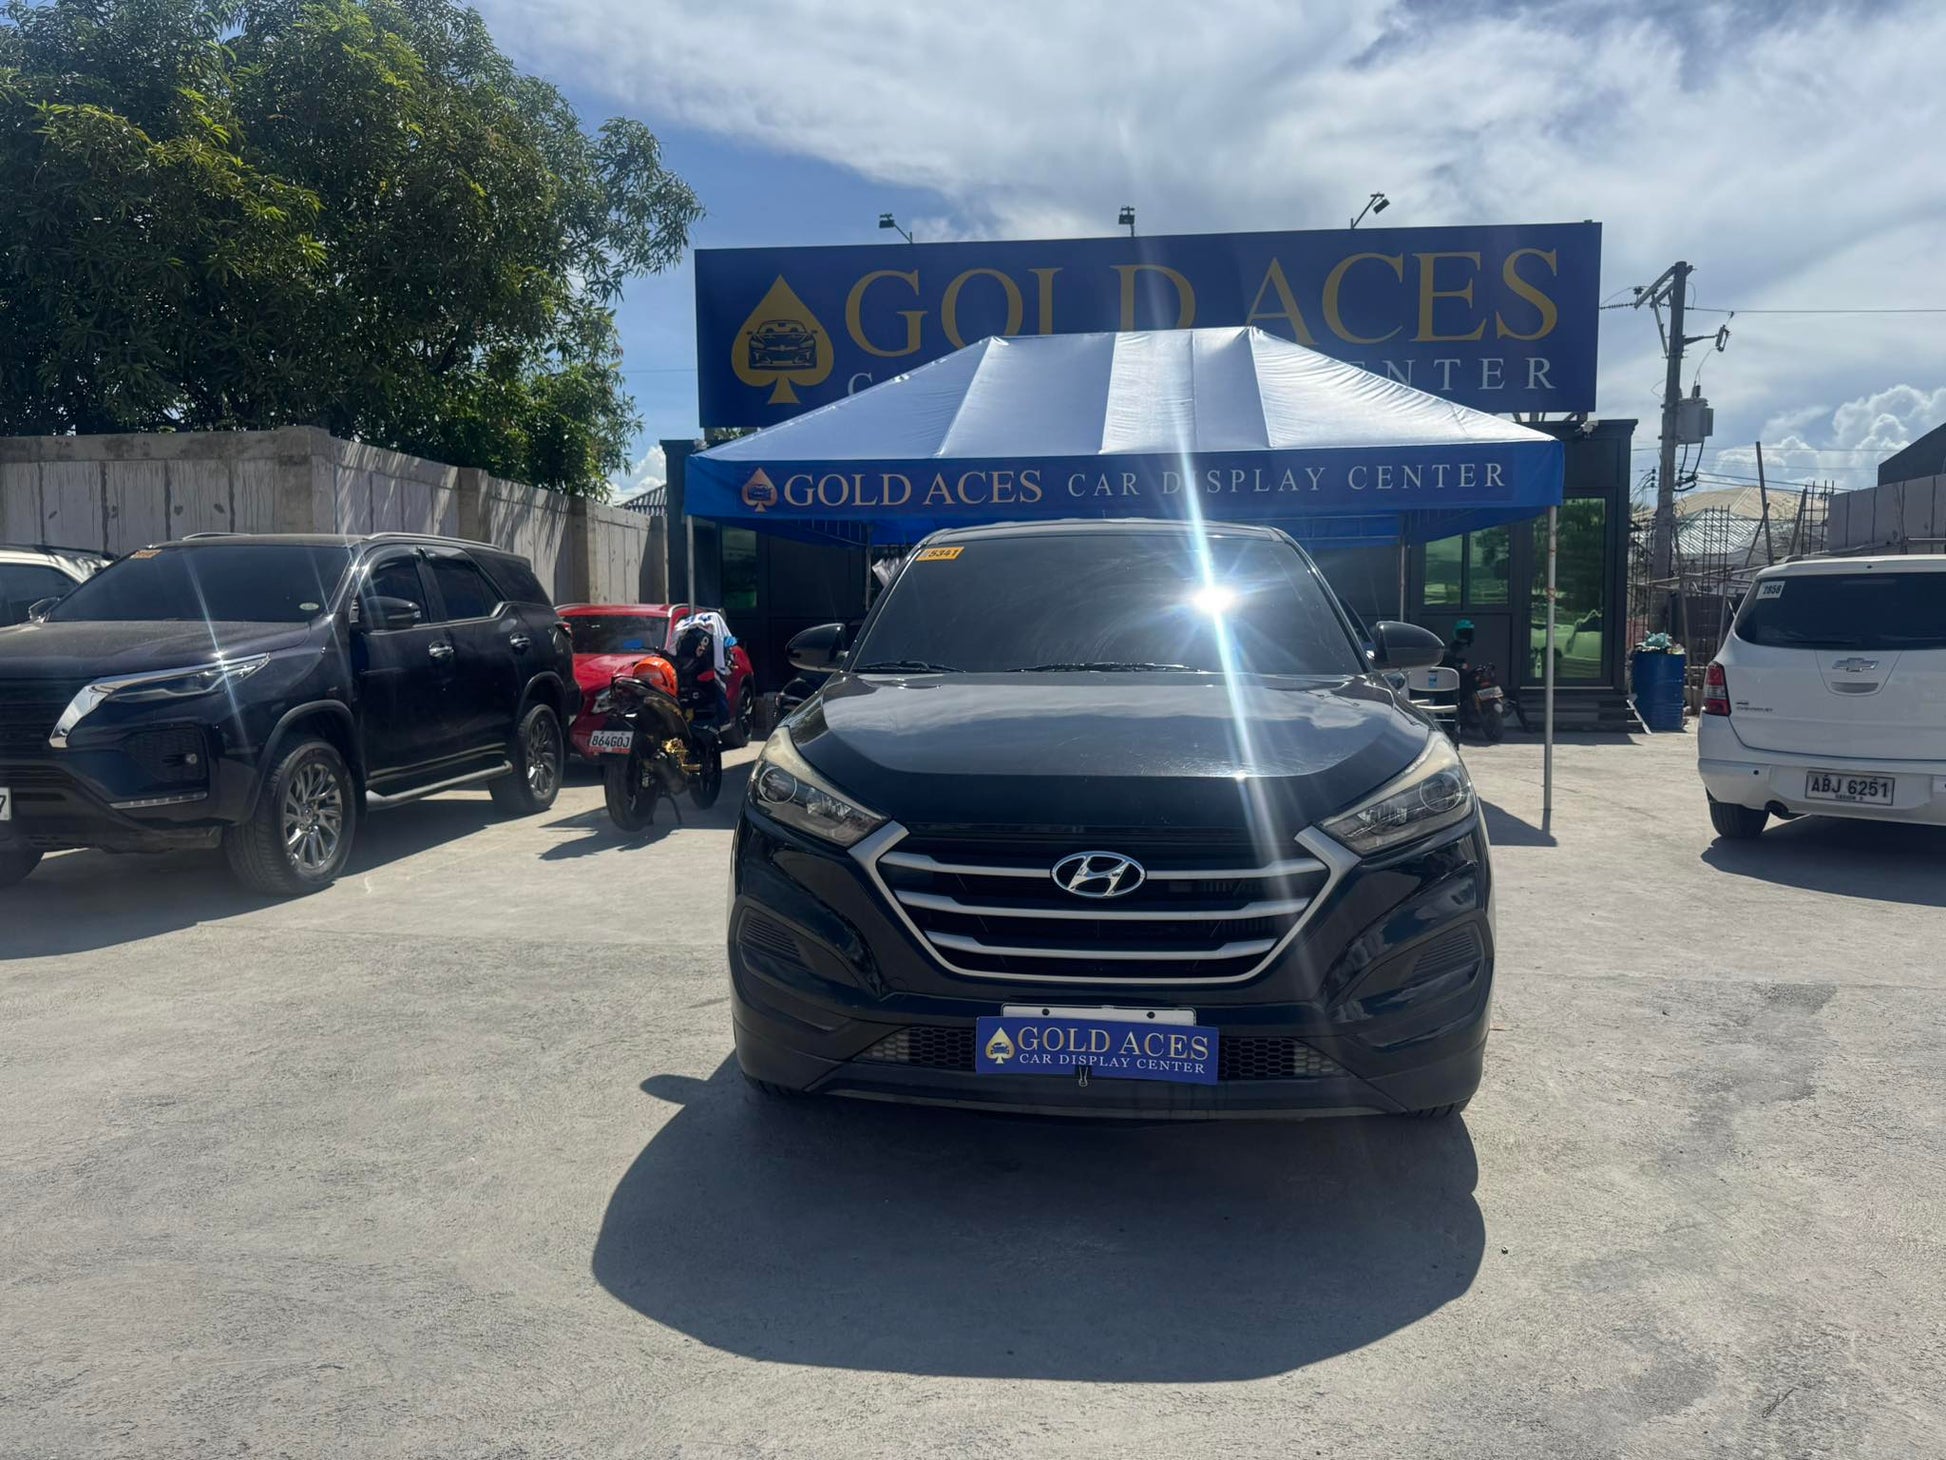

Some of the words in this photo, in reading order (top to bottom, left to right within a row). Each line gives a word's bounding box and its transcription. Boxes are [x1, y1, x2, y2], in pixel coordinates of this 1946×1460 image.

[1246, 248, 1558, 346] ACES
[784, 473, 912, 507] GOLD
[922, 469, 1043, 505] ACES
[1068, 472, 1140, 497] CAR
[1348, 463, 1506, 490] CENTER
[1811, 776, 1841, 793] ABJ
[1847, 780, 1888, 798] 6251
[1017, 1026, 1111, 1053] GOLD
[1120, 1031, 1209, 1061] ACES
[1019, 1053, 1052, 1064] CAR
[1059, 1055, 1130, 1068] DISPLAY
[1136, 1059, 1205, 1074] CENTER
